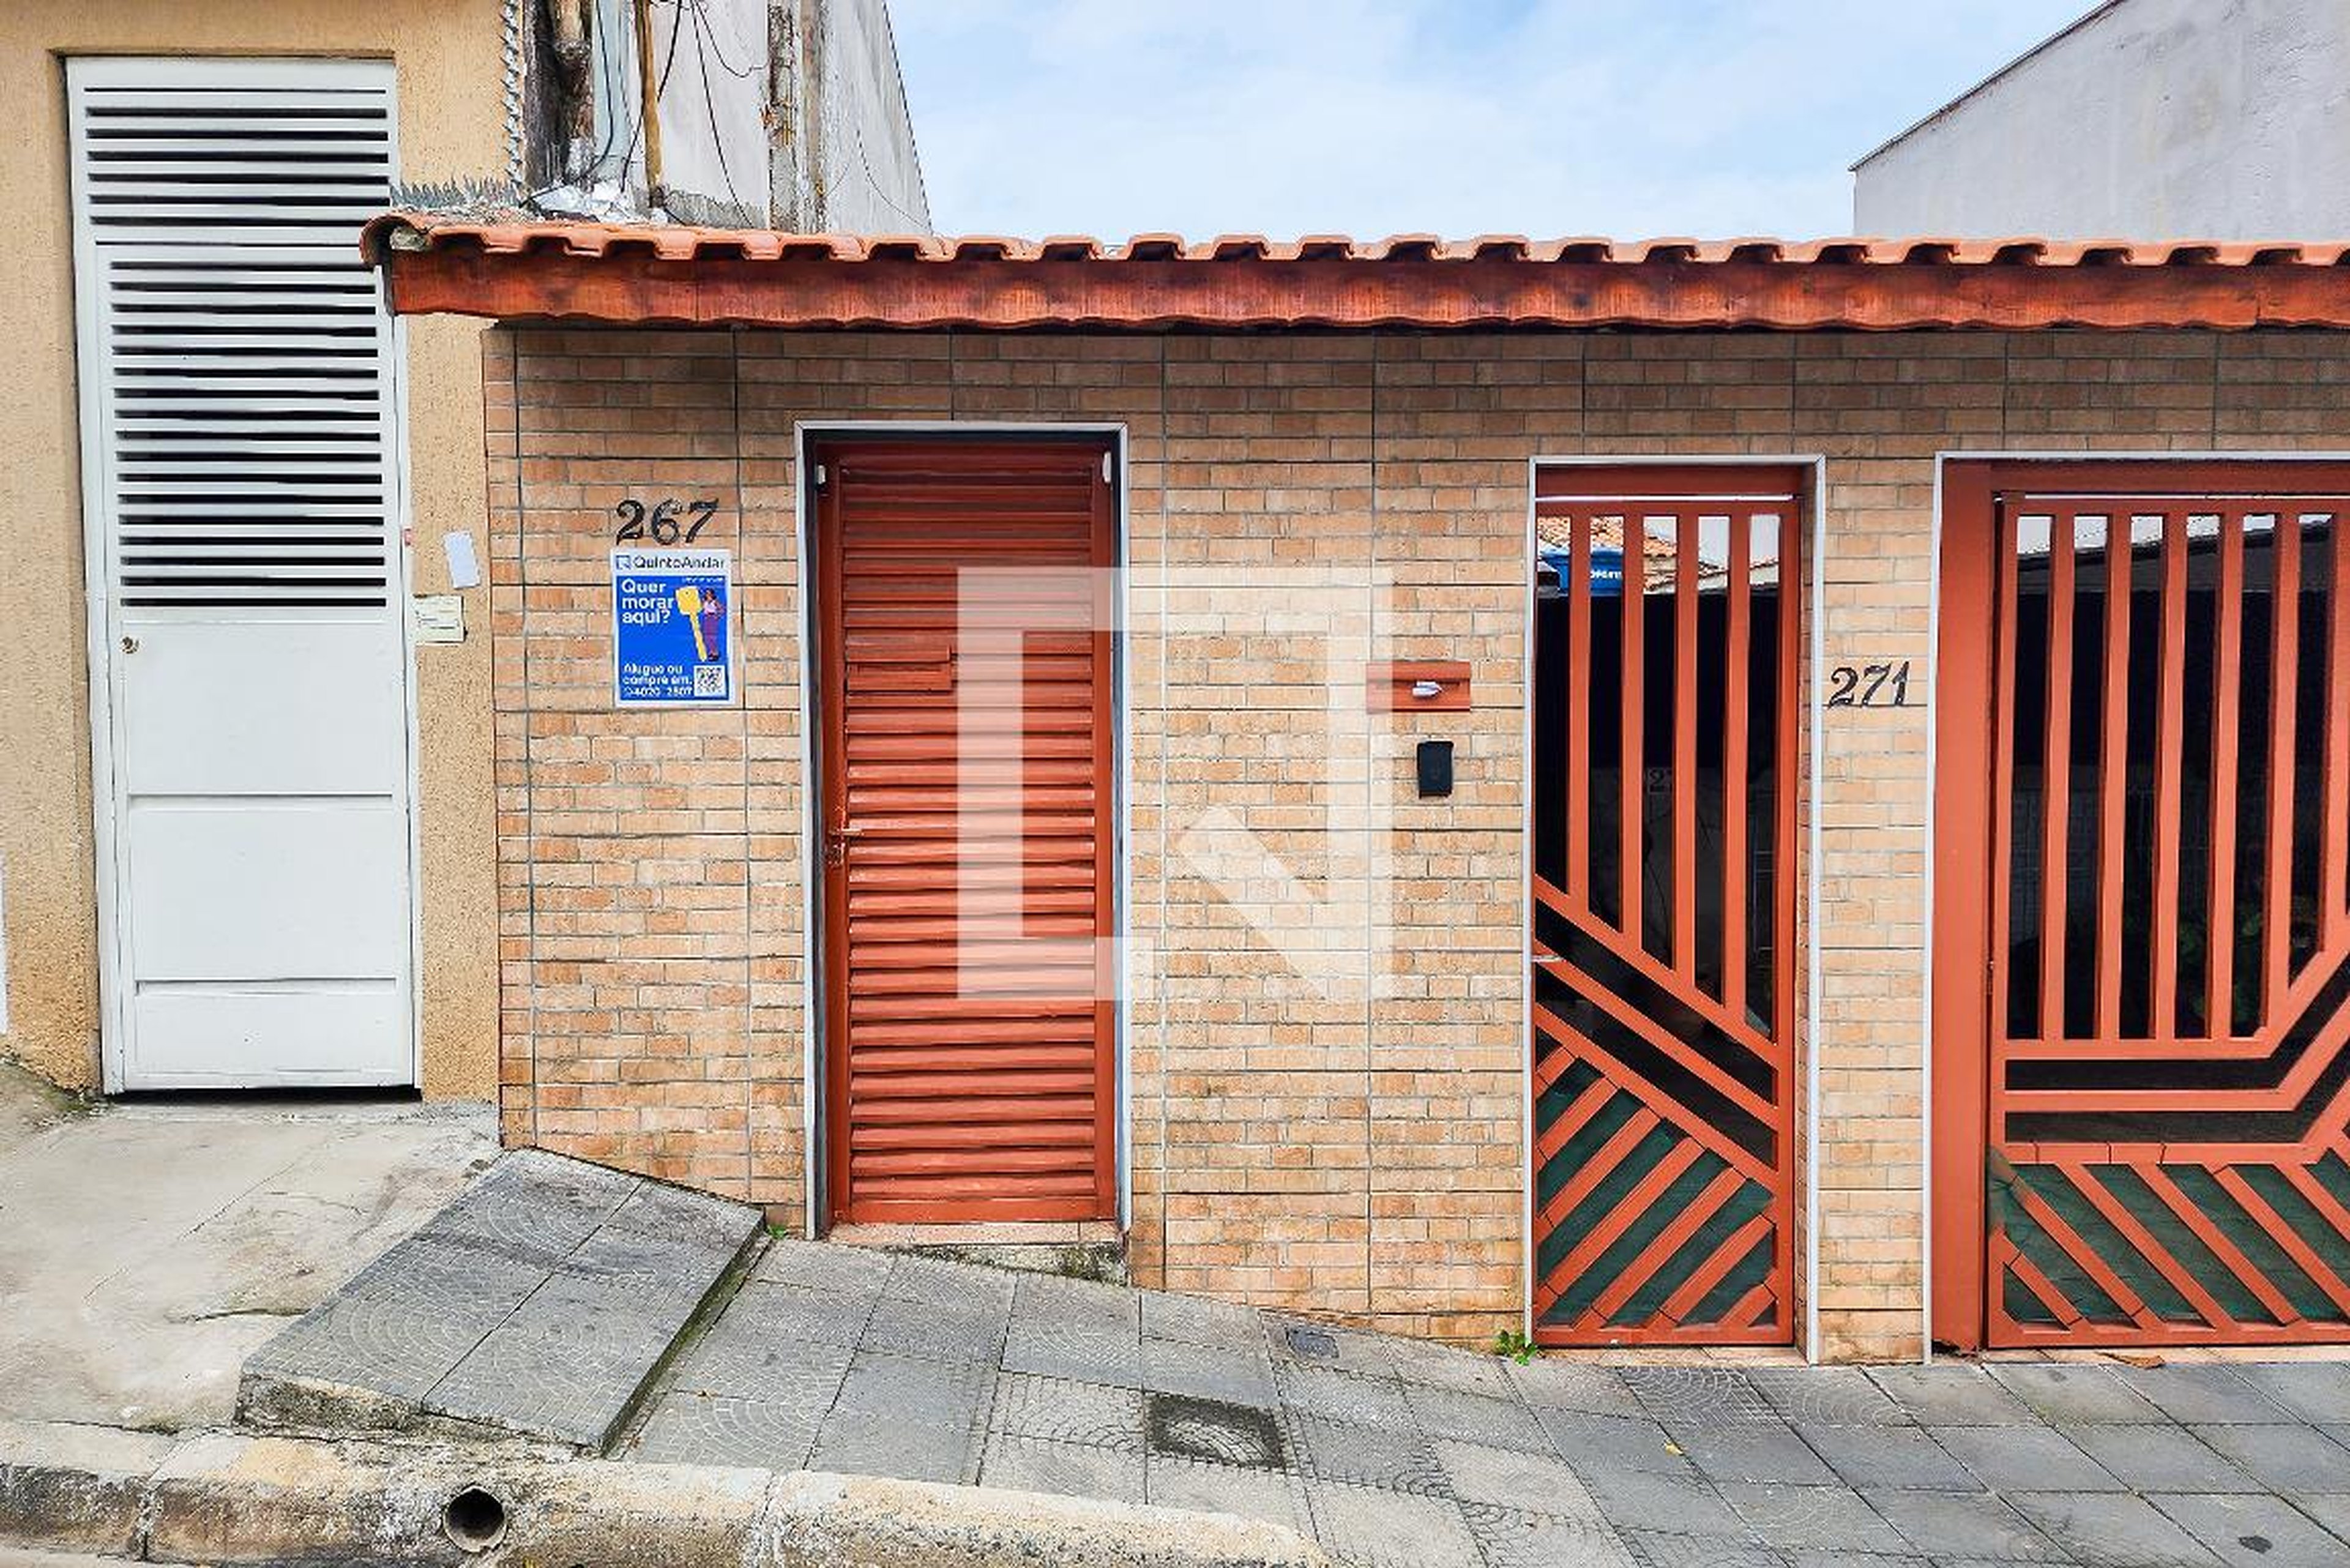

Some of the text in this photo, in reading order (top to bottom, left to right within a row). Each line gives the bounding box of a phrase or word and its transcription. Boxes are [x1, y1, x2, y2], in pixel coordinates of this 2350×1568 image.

[616, 498, 719, 545] 267
[633, 556, 725, 569] QuintoAndar
[621, 578, 666, 594] Quer
[621, 597, 674, 610] morar
[622, 610, 671, 626] aqui?
[624, 663, 682, 676] Alugue ou
[623, 676, 668, 687] compre
[1827, 661, 1910, 708] 271
